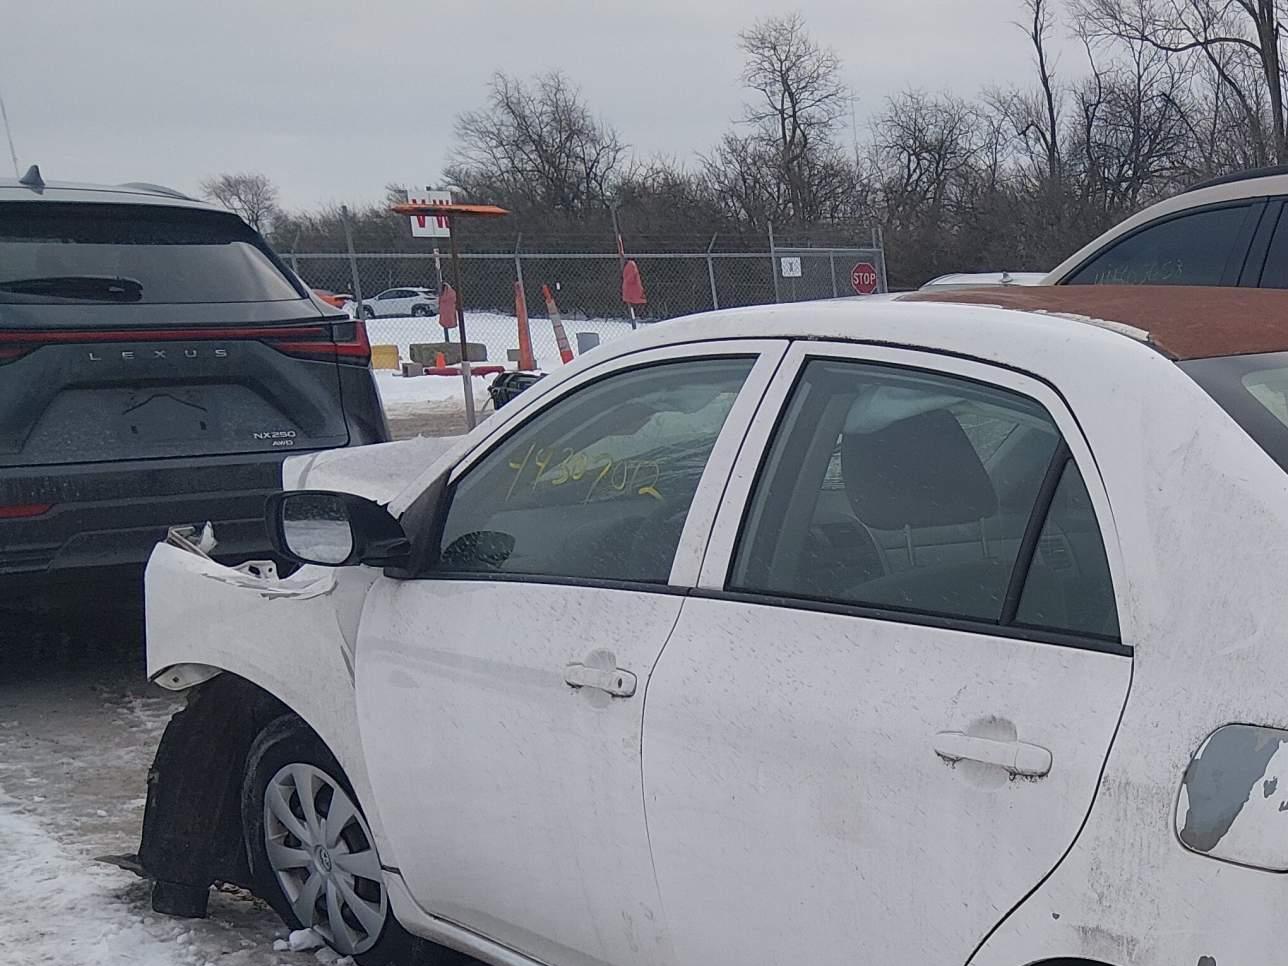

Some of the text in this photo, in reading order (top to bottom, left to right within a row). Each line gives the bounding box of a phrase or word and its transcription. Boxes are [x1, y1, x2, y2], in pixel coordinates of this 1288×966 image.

[852, 272, 876, 285] STOP
[89, 349, 228, 361] LEXUS
[253, 430, 296, 440] NX250
[271, 439, 294, 447] AWD
